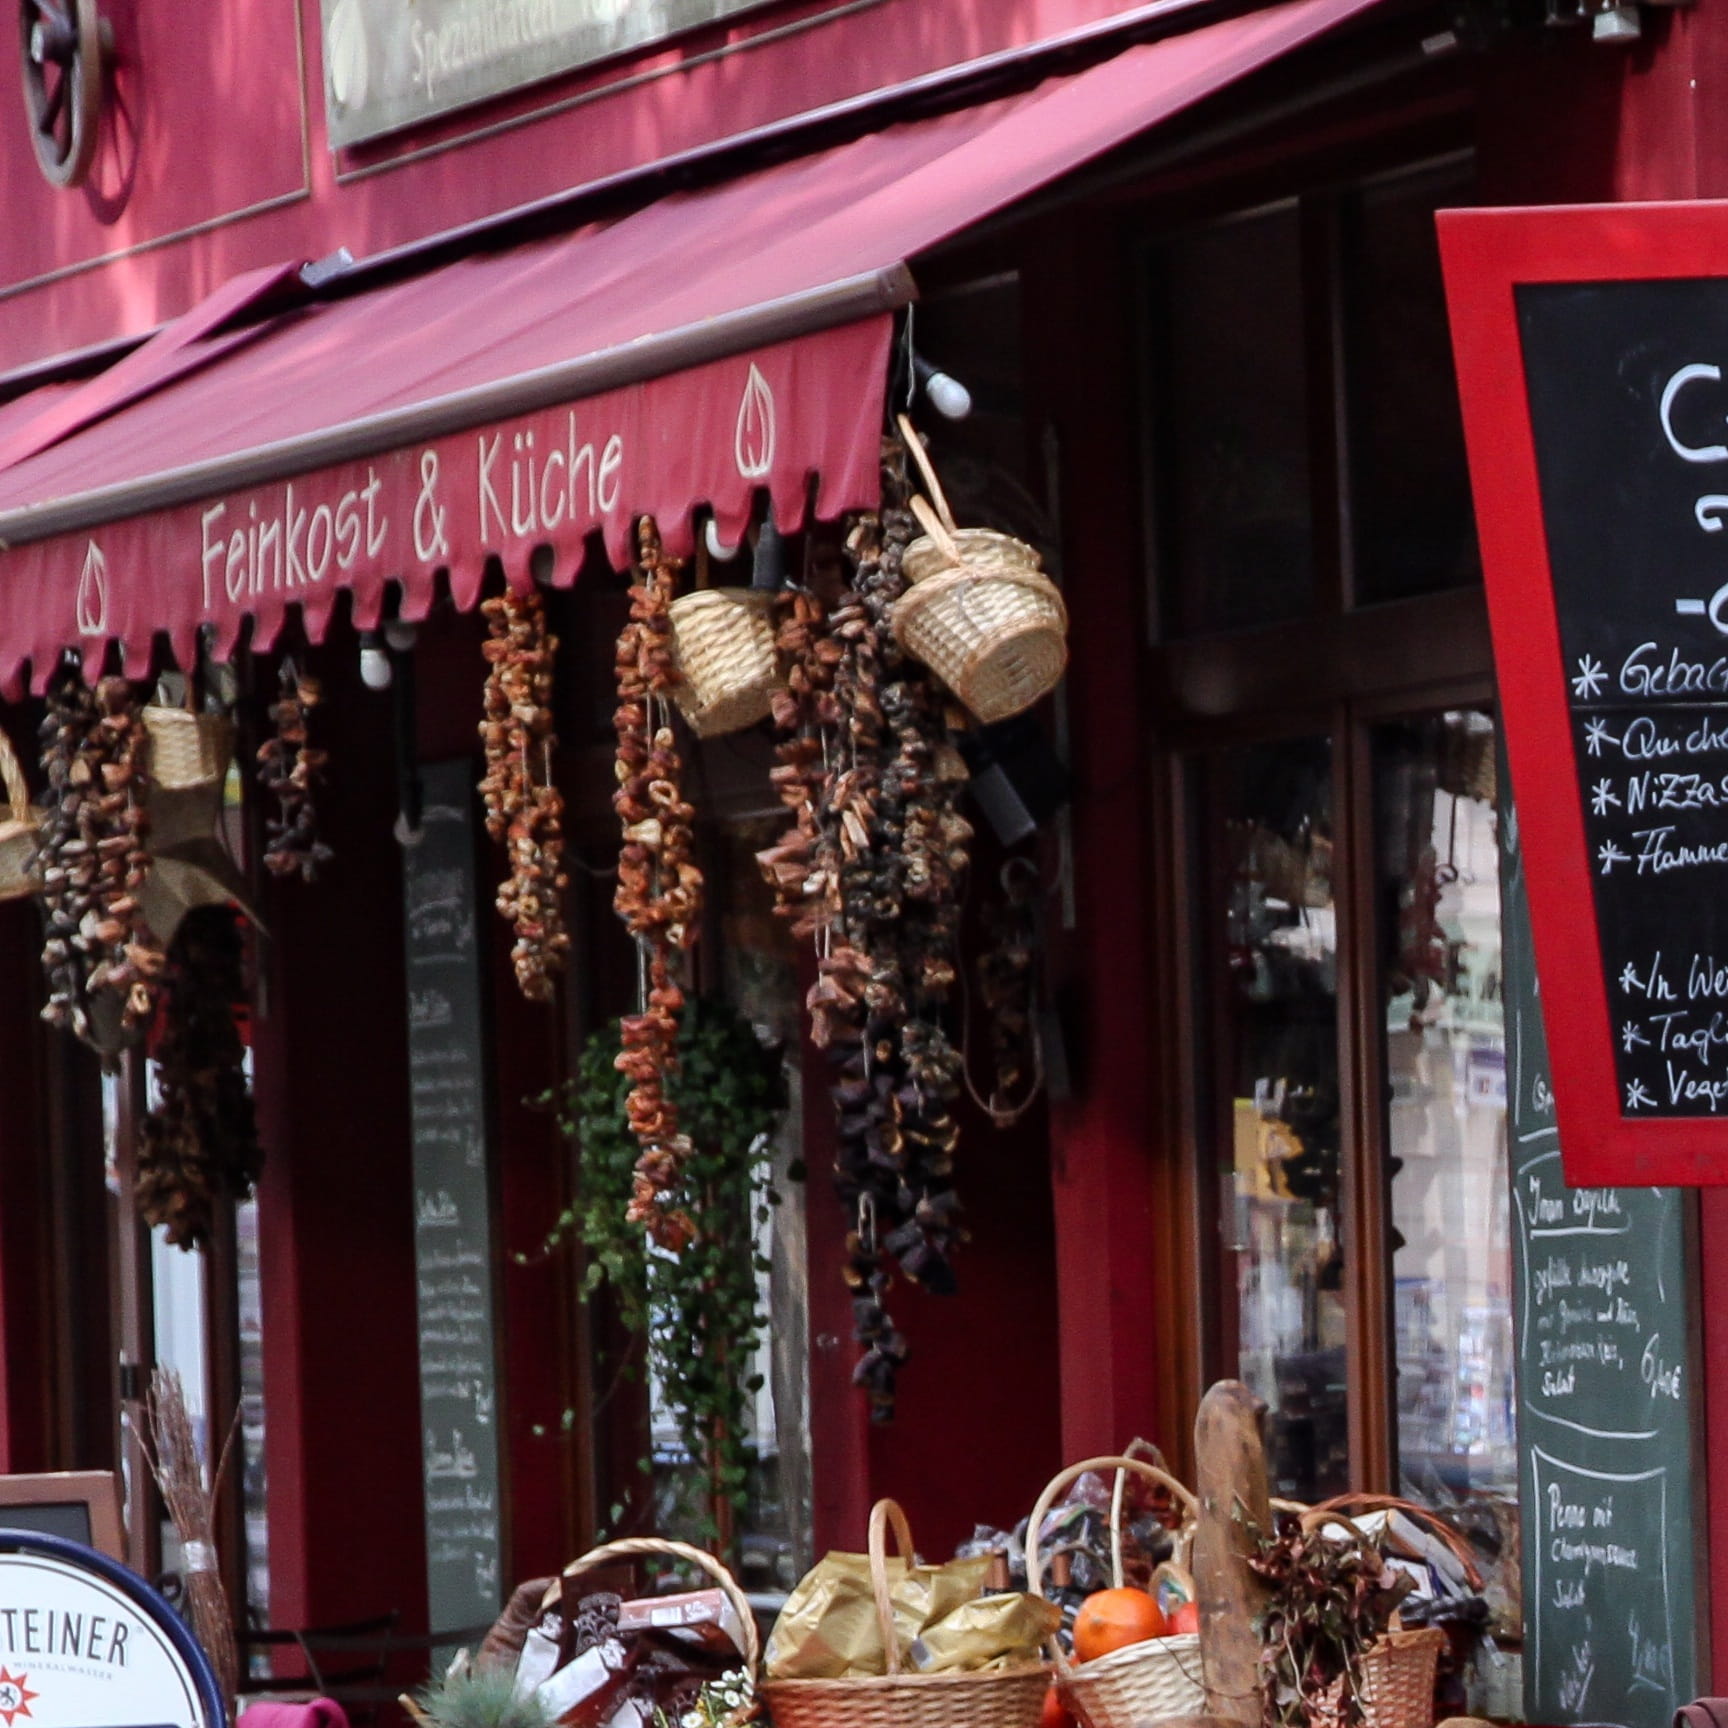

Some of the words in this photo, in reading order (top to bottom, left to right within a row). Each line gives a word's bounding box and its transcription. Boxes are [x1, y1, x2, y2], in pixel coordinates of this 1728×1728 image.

[201, 465, 388, 609] Feinkost
[412, 448, 449, 563] &
[478, 409, 623, 545] Küche
